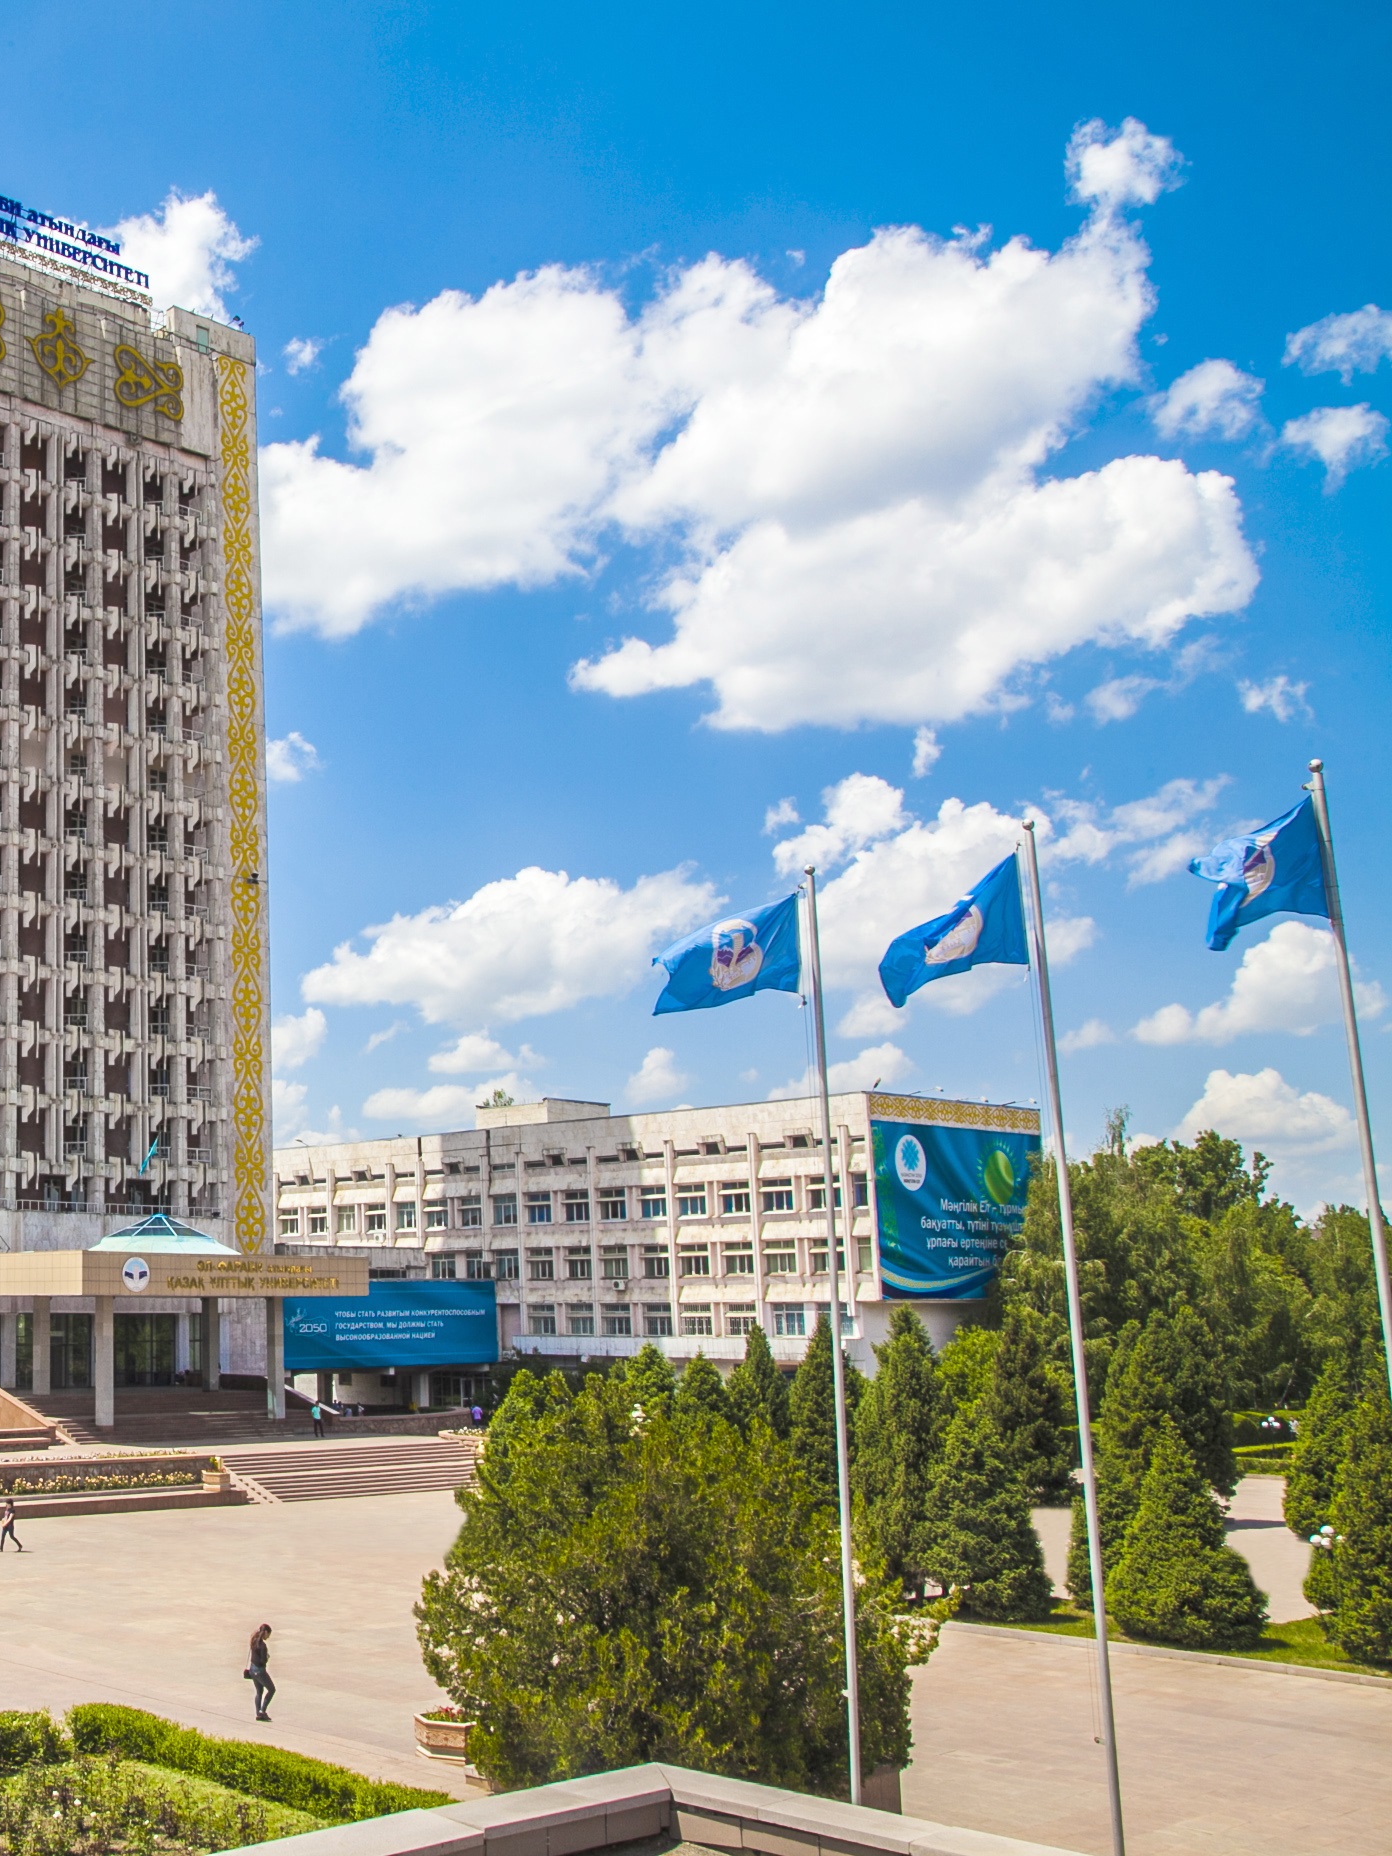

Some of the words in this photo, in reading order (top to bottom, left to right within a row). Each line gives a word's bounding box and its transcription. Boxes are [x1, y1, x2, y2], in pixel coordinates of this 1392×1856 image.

[335, 1310, 357, 1318] ЧТОБЫ
[357, 1310, 376, 1318] СТАТЬ
[376, 1309, 410, 1317] РАЗВИТЫМ
[299, 1323, 327, 1333] 2050
[386, 1321, 398, 1329] МЫ
[399, 1321, 426, 1329] ДОЛЖНЫ
[427, 1320, 444, 1328] СТАТЬ
